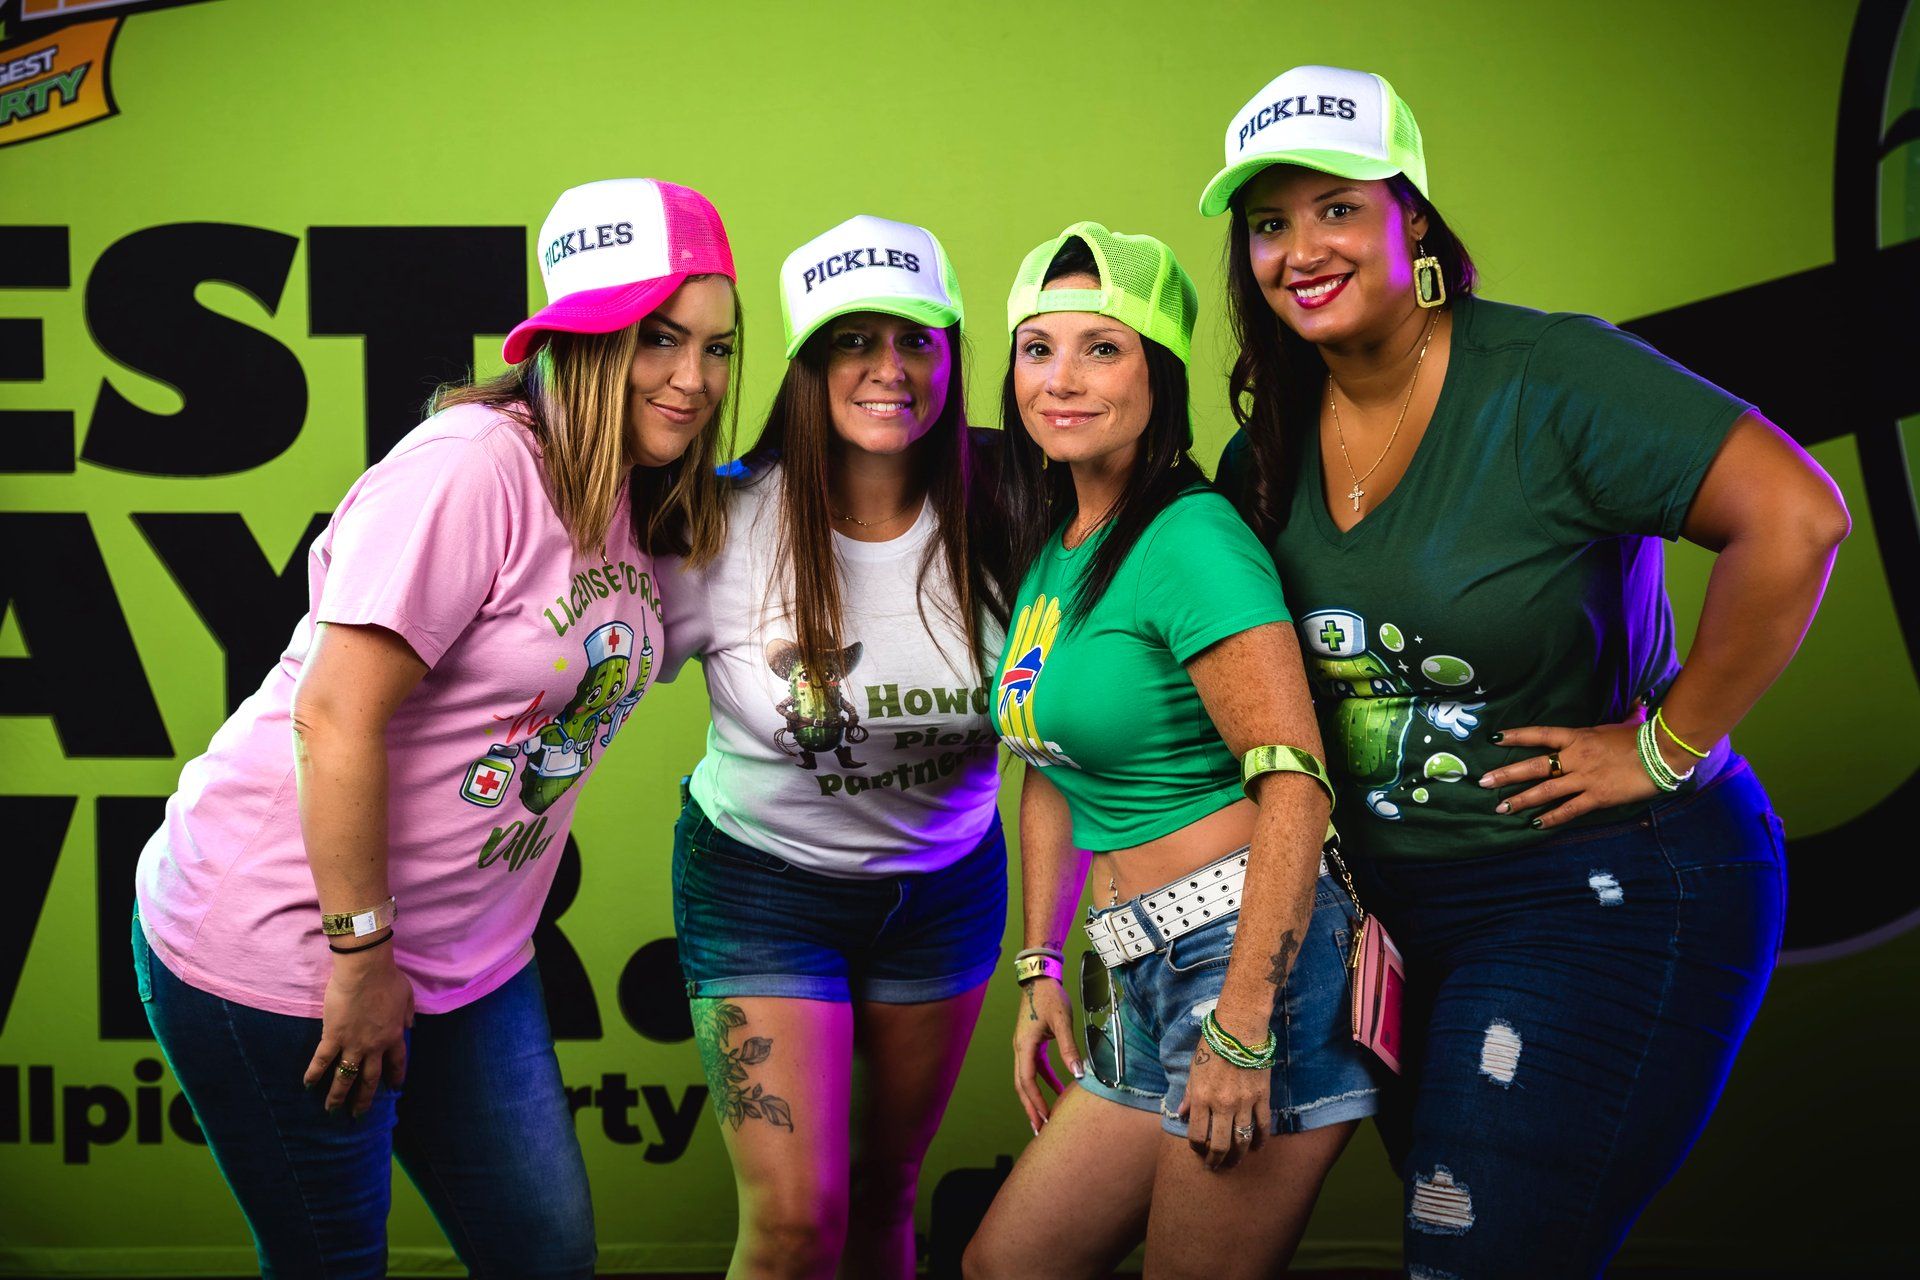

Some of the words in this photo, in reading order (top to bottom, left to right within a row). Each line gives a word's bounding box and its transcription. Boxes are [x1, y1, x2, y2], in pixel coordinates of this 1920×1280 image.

[1239, 95, 1357, 152] PICKLES
[545, 221, 633, 275] PICKLES
[803, 247, 921, 294] PICKLES
[1030, 959, 1050, 971] VIP
